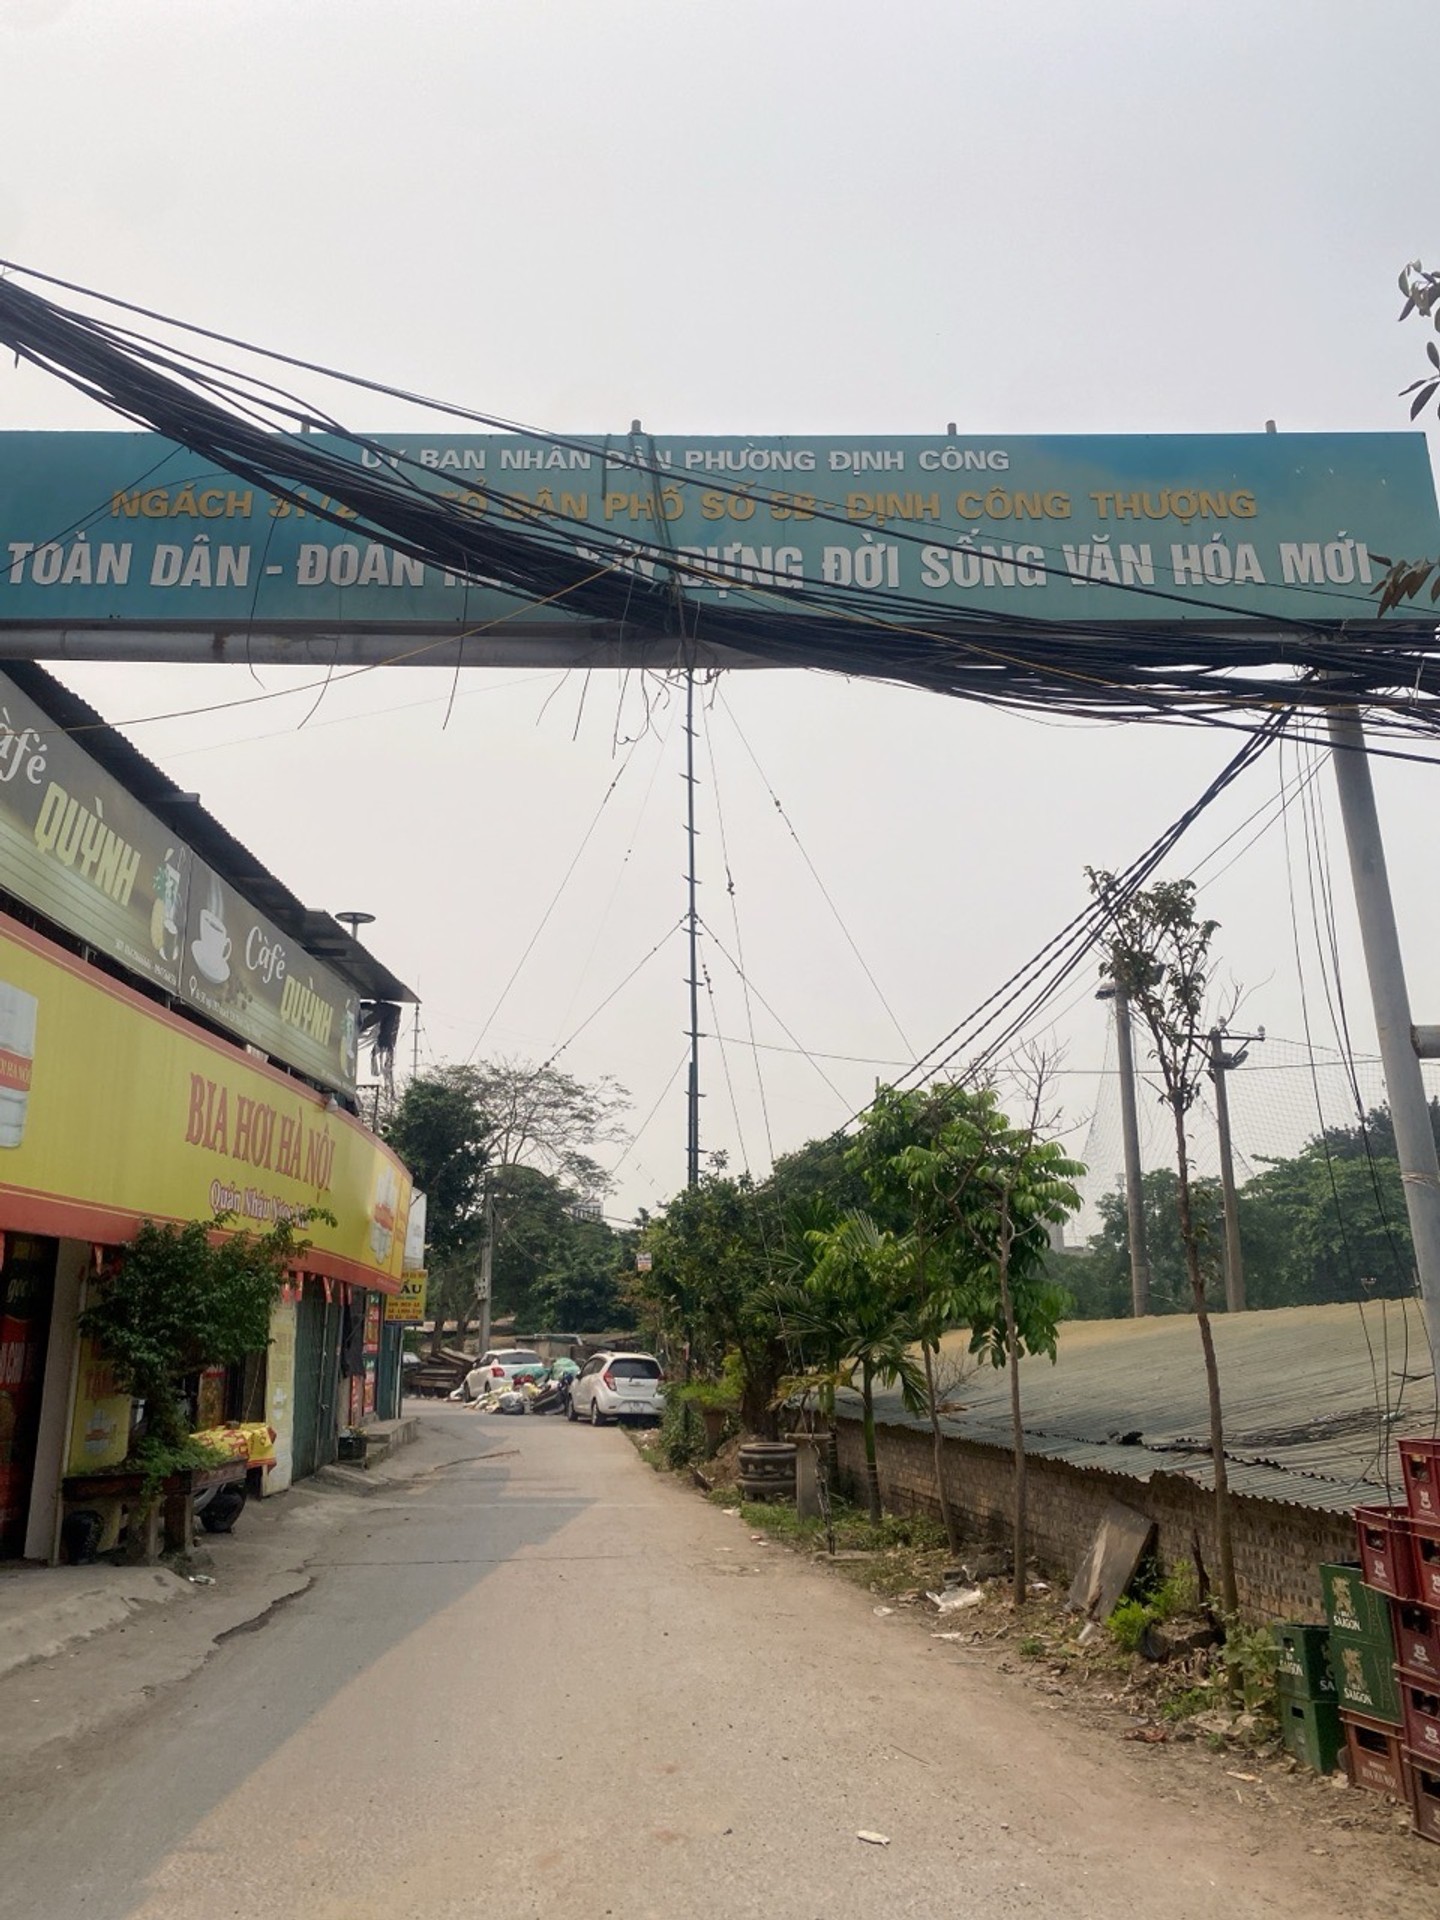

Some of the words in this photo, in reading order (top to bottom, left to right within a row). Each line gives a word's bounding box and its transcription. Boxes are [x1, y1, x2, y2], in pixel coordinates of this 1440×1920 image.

[420, 449, 487, 470] BAN
[501, 446, 592, 470] NHÂN
[605, 446, 672, 470] DÂN
[685, 443, 816, 471] PHƯỜNG
[828, 449, 905, 475] ĐỊNH
[918, 446, 1010, 471] CÔNG
[111, 484, 254, 519] NGÁCH
[502, 489, 588, 520] DÂN
[604, 482, 685, 521] PHỐ
[701, 481, 757, 522] SỐ
[847, 490, 941, 527] ĐỊNH
[956, 488, 1071, 520] CÔNG
[1091, 488, 1258, 525] THƯỢNG
[7, 530, 133, 586] TOÀN
[150, 534, 250, 588] DÂN
[676, 542, 804, 600] DỰNG
[822, 533, 900, 588] ĐỜI
[920, 529, 1047, 589] SỐNG
[1062, 534, 1155, 586] VĂN
[1171, 532, 1266, 586] HÓA
[1279, 530, 1373, 585] MỚI
[34, 781, 141, 907] QUỲNH
[280, 975, 334, 1047] QUỲNH
[185, 1072, 228, 1156] BIA
[232, 1093, 277, 1171] HƠI
[275, 1105, 303, 1180] HÀ
[304, 1125, 336, 1204] NỘI
[1333, 1614, 1362, 1631] SAIGON
[1343, 1687, 1373, 1705] SAIGON
